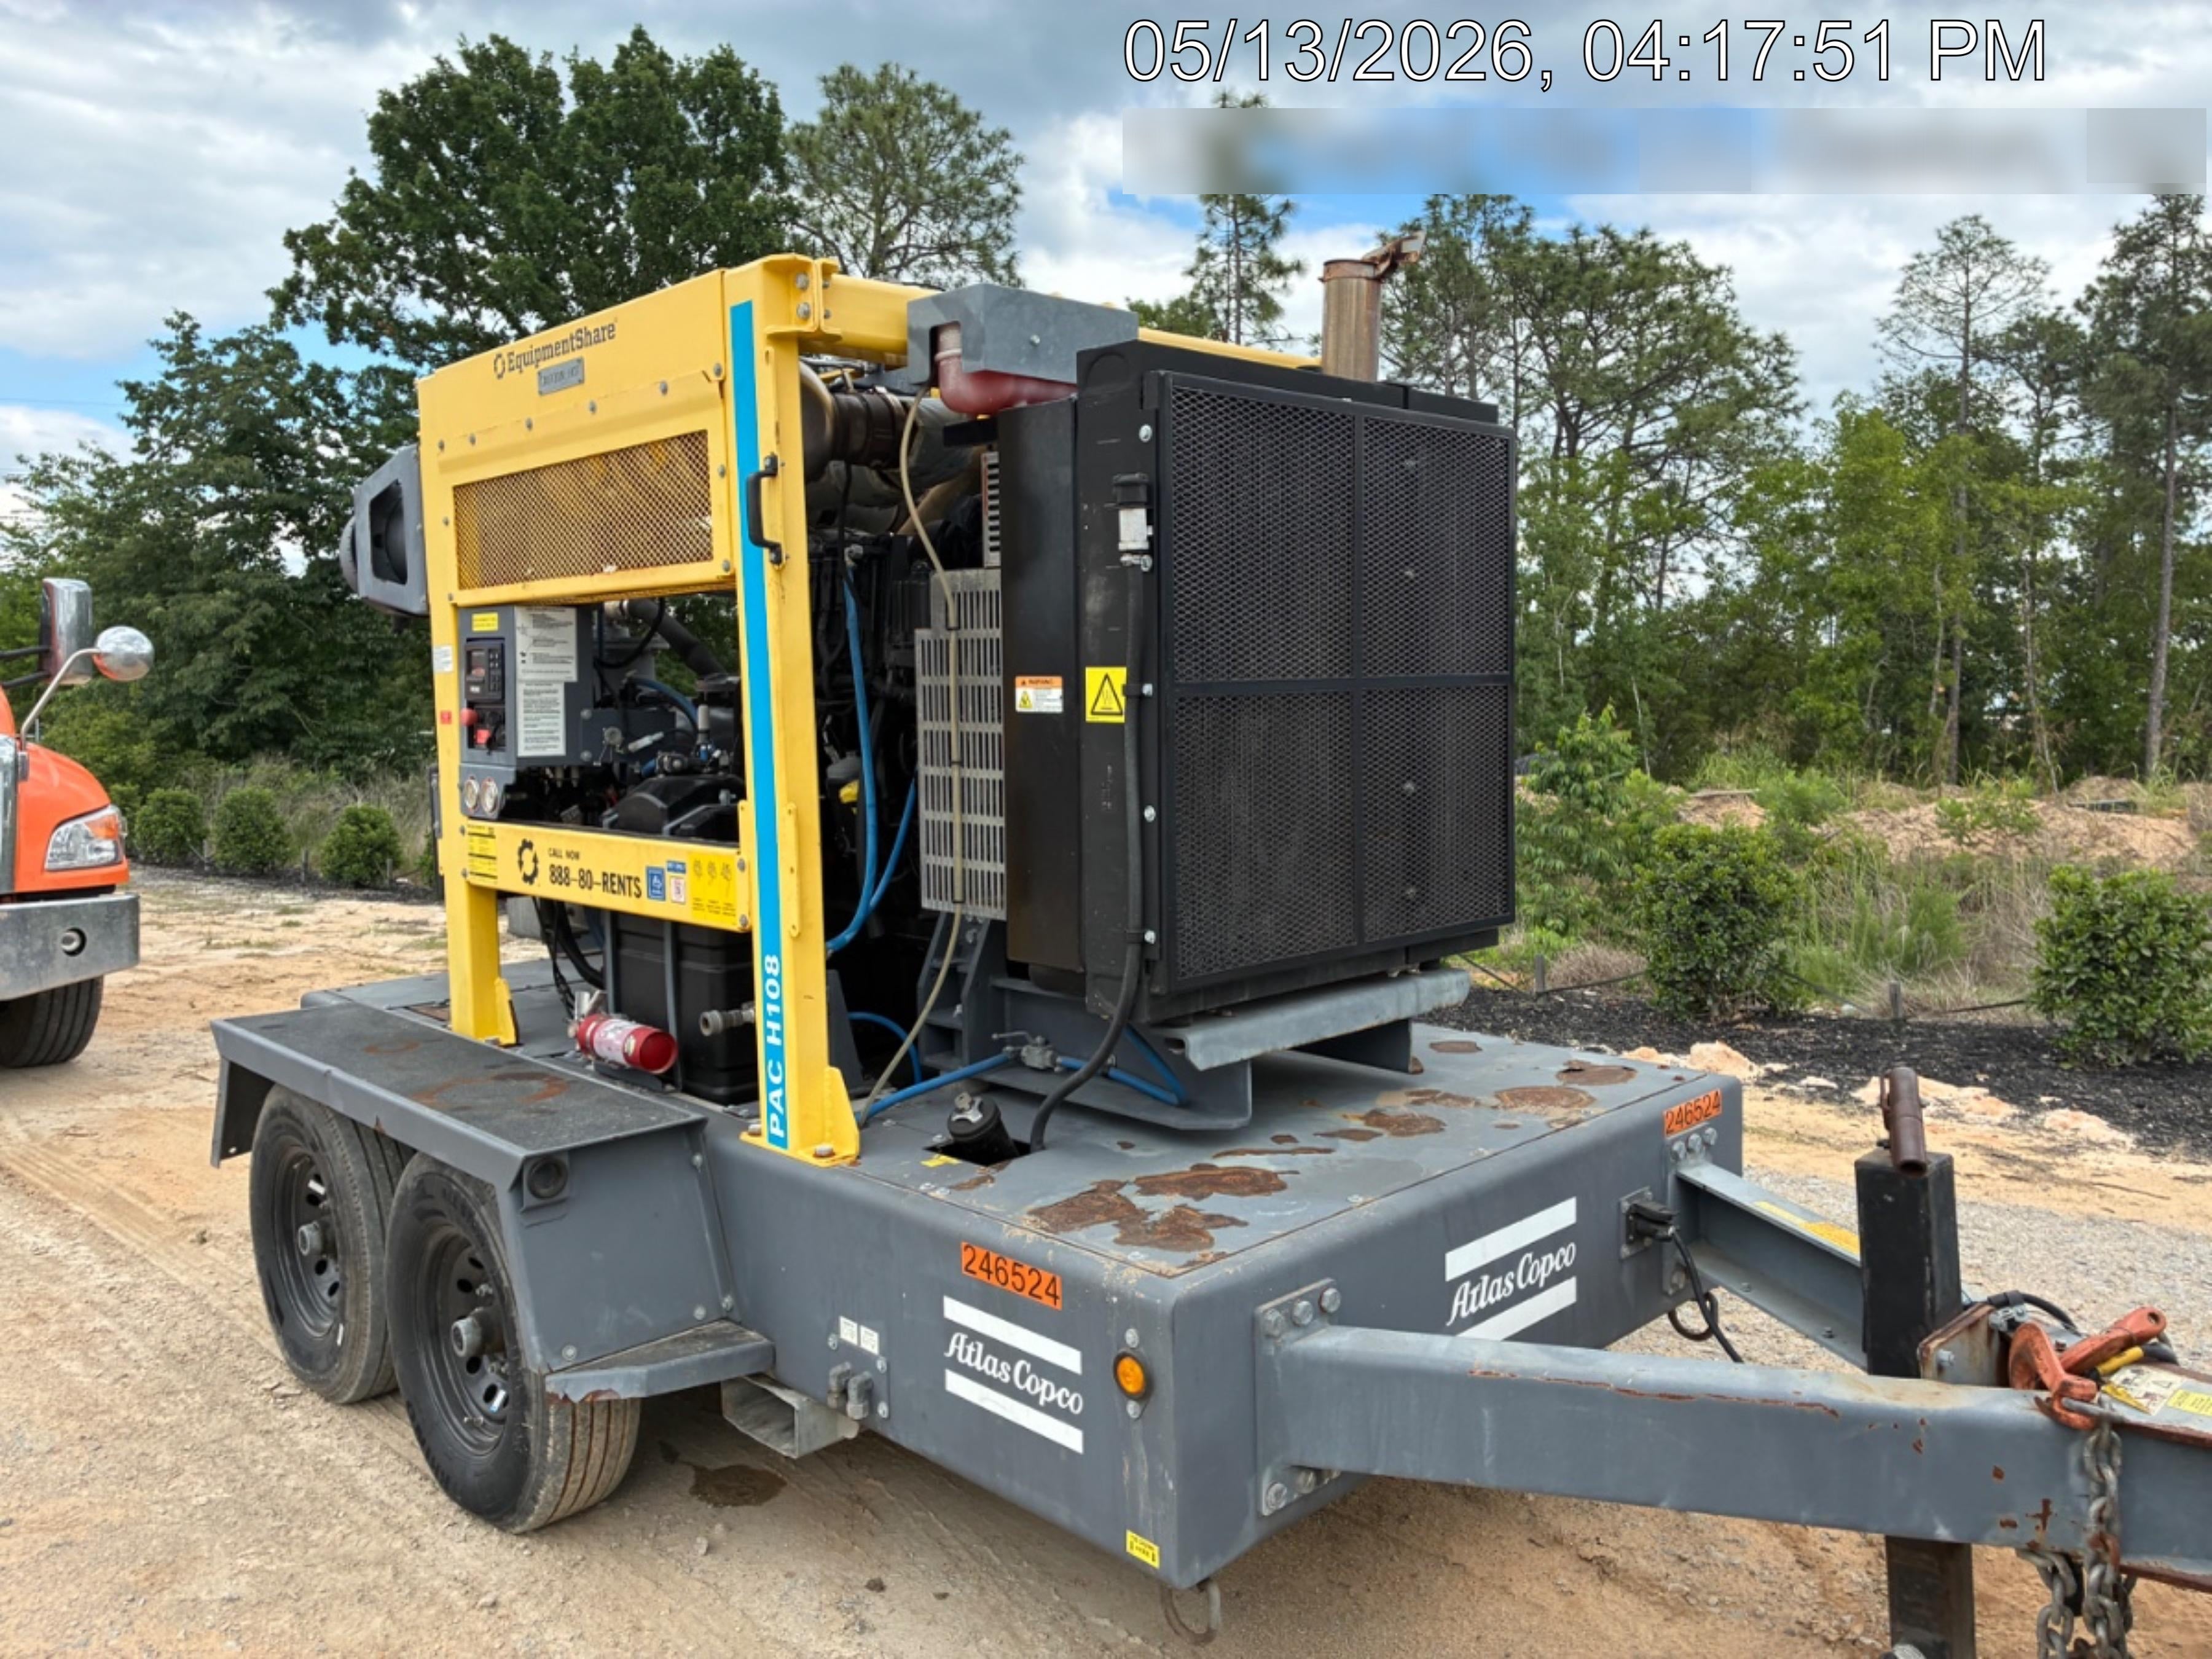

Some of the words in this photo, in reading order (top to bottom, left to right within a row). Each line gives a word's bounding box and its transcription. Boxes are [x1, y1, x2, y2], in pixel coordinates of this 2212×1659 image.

[507, 323, 616, 373] EquipmentShare
[547, 847, 562, 859] CALL
[565, 849, 579, 861] NOW
[549, 864, 642, 898] 888-80-RENTS
[764, 954, 782, 1046] H108
[768, 1059, 785, 1139] PAC
[1665, 1091, 1720, 1135] 246524
[963, 1245, 1060, 1306] 246524
[1446, 1272, 1515, 1327] Atlas
[1516, 1242, 1577, 1289] Copco
[944, 1332, 1011, 1383] Atlas
[1013, 1360, 1084, 1414] Copco
